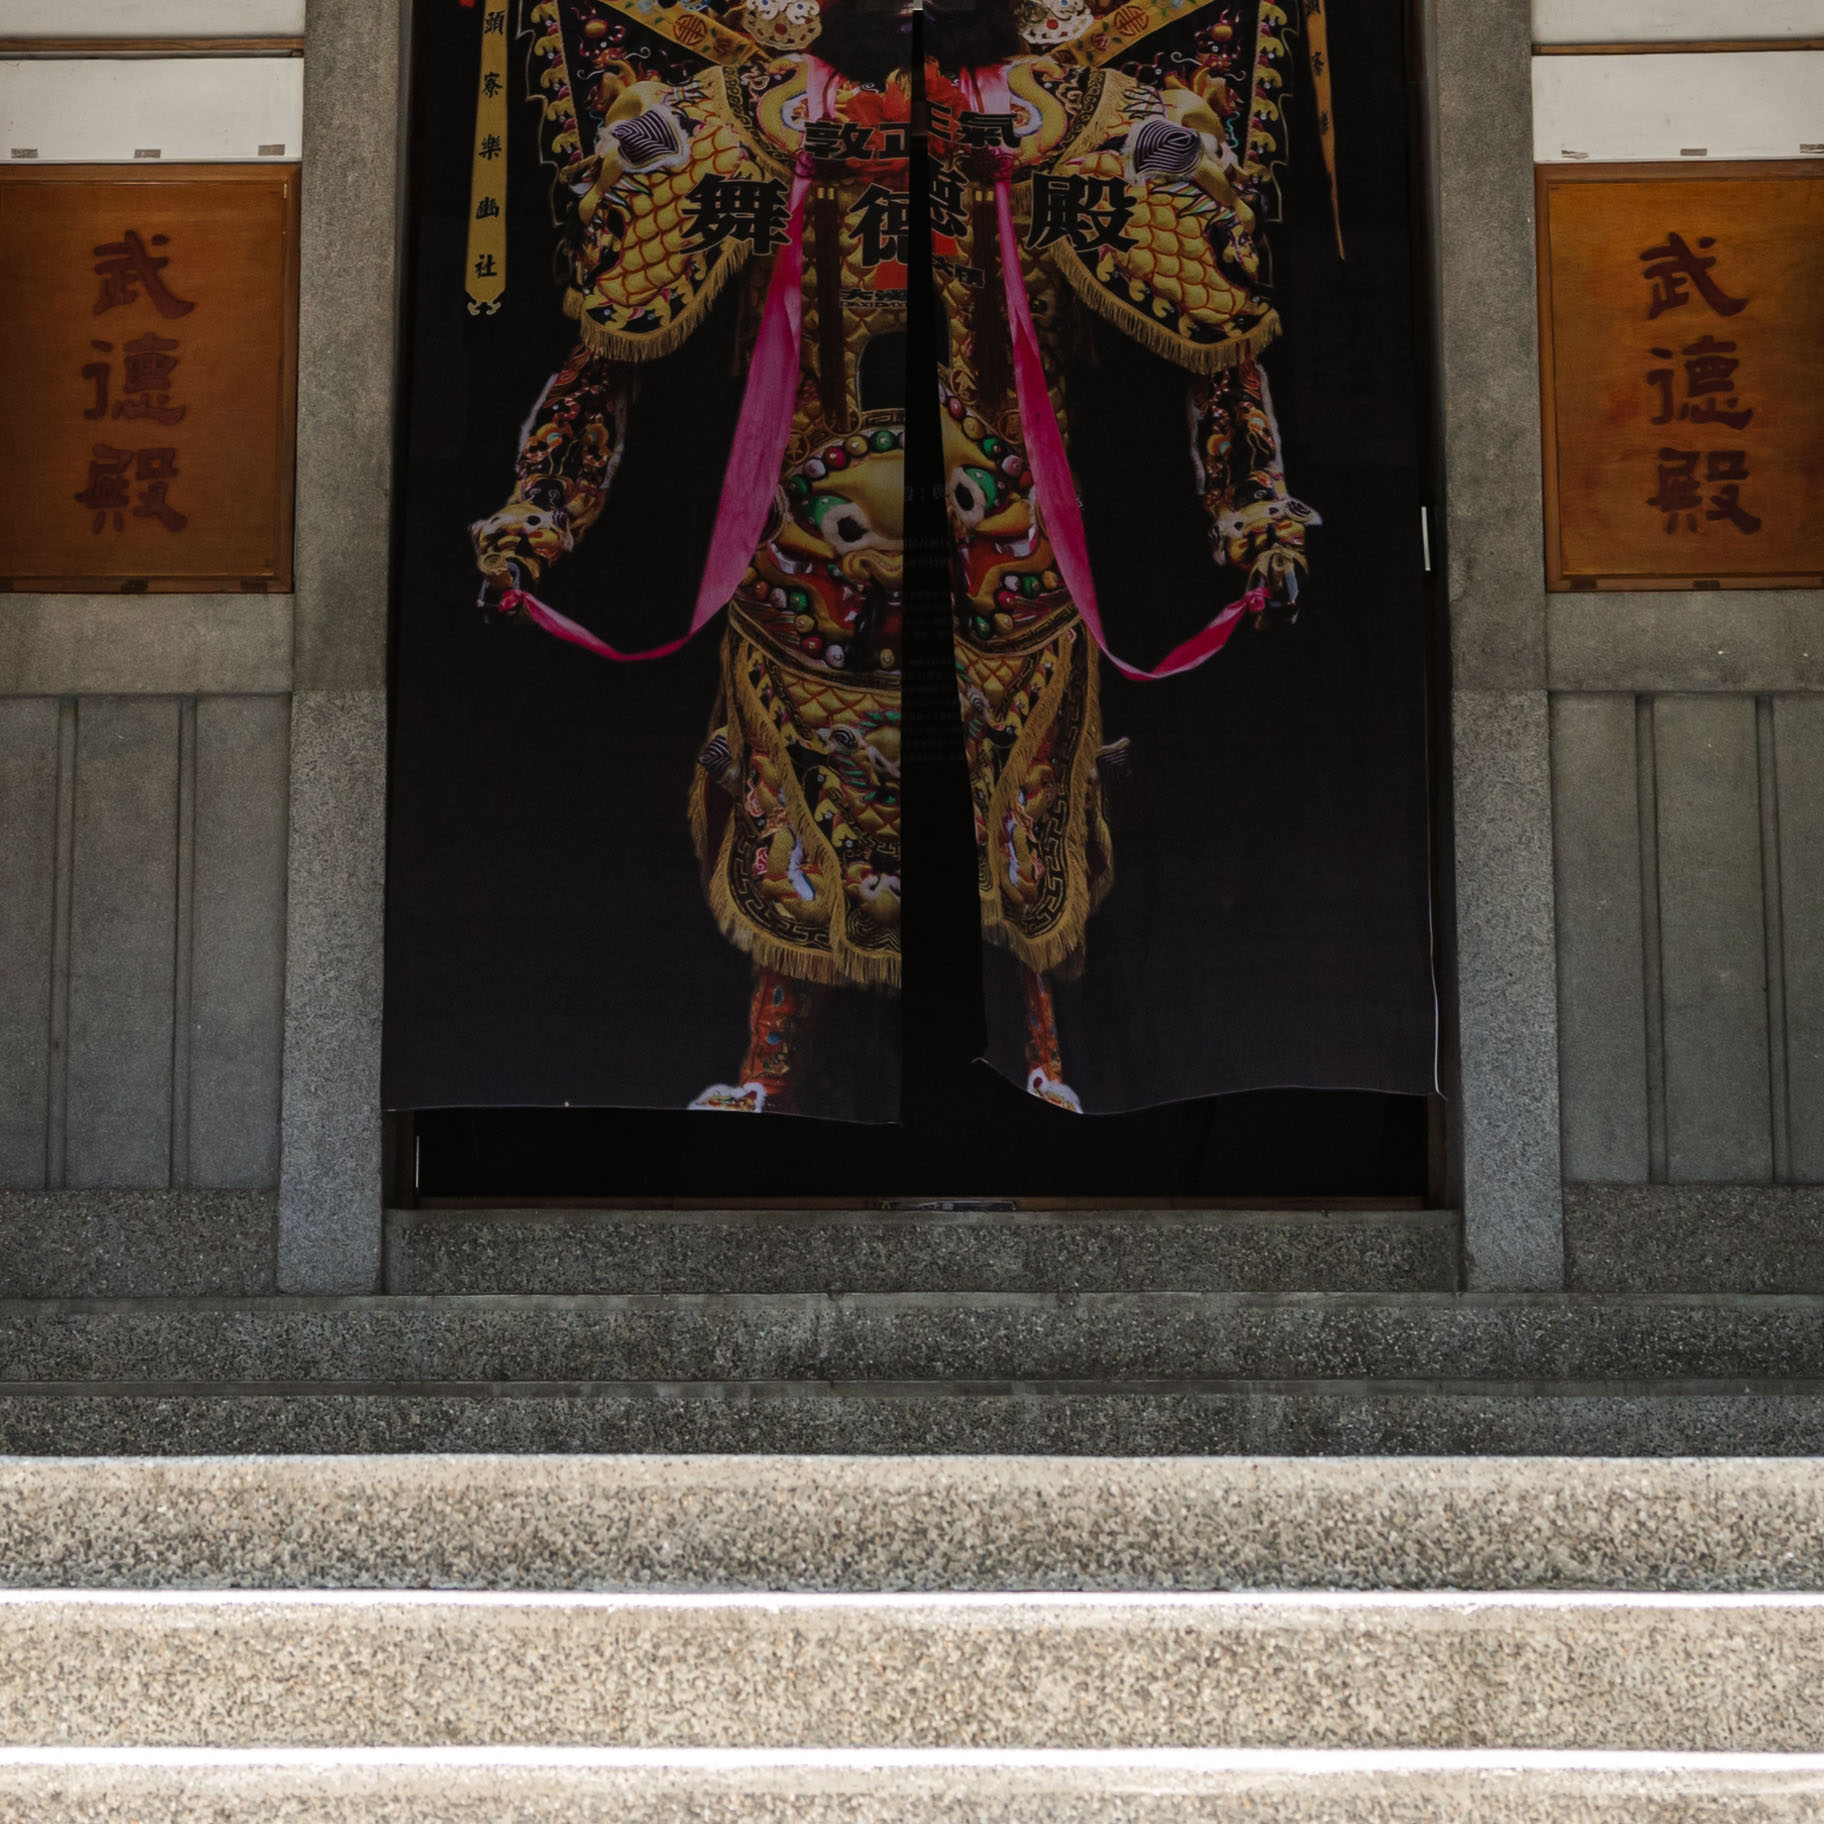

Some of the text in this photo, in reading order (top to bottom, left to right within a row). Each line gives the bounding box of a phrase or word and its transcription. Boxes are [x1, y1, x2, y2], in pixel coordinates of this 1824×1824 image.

[74, 229, 196, 534] 武德殿
[1639, 231, 1762, 535] 武德殿
